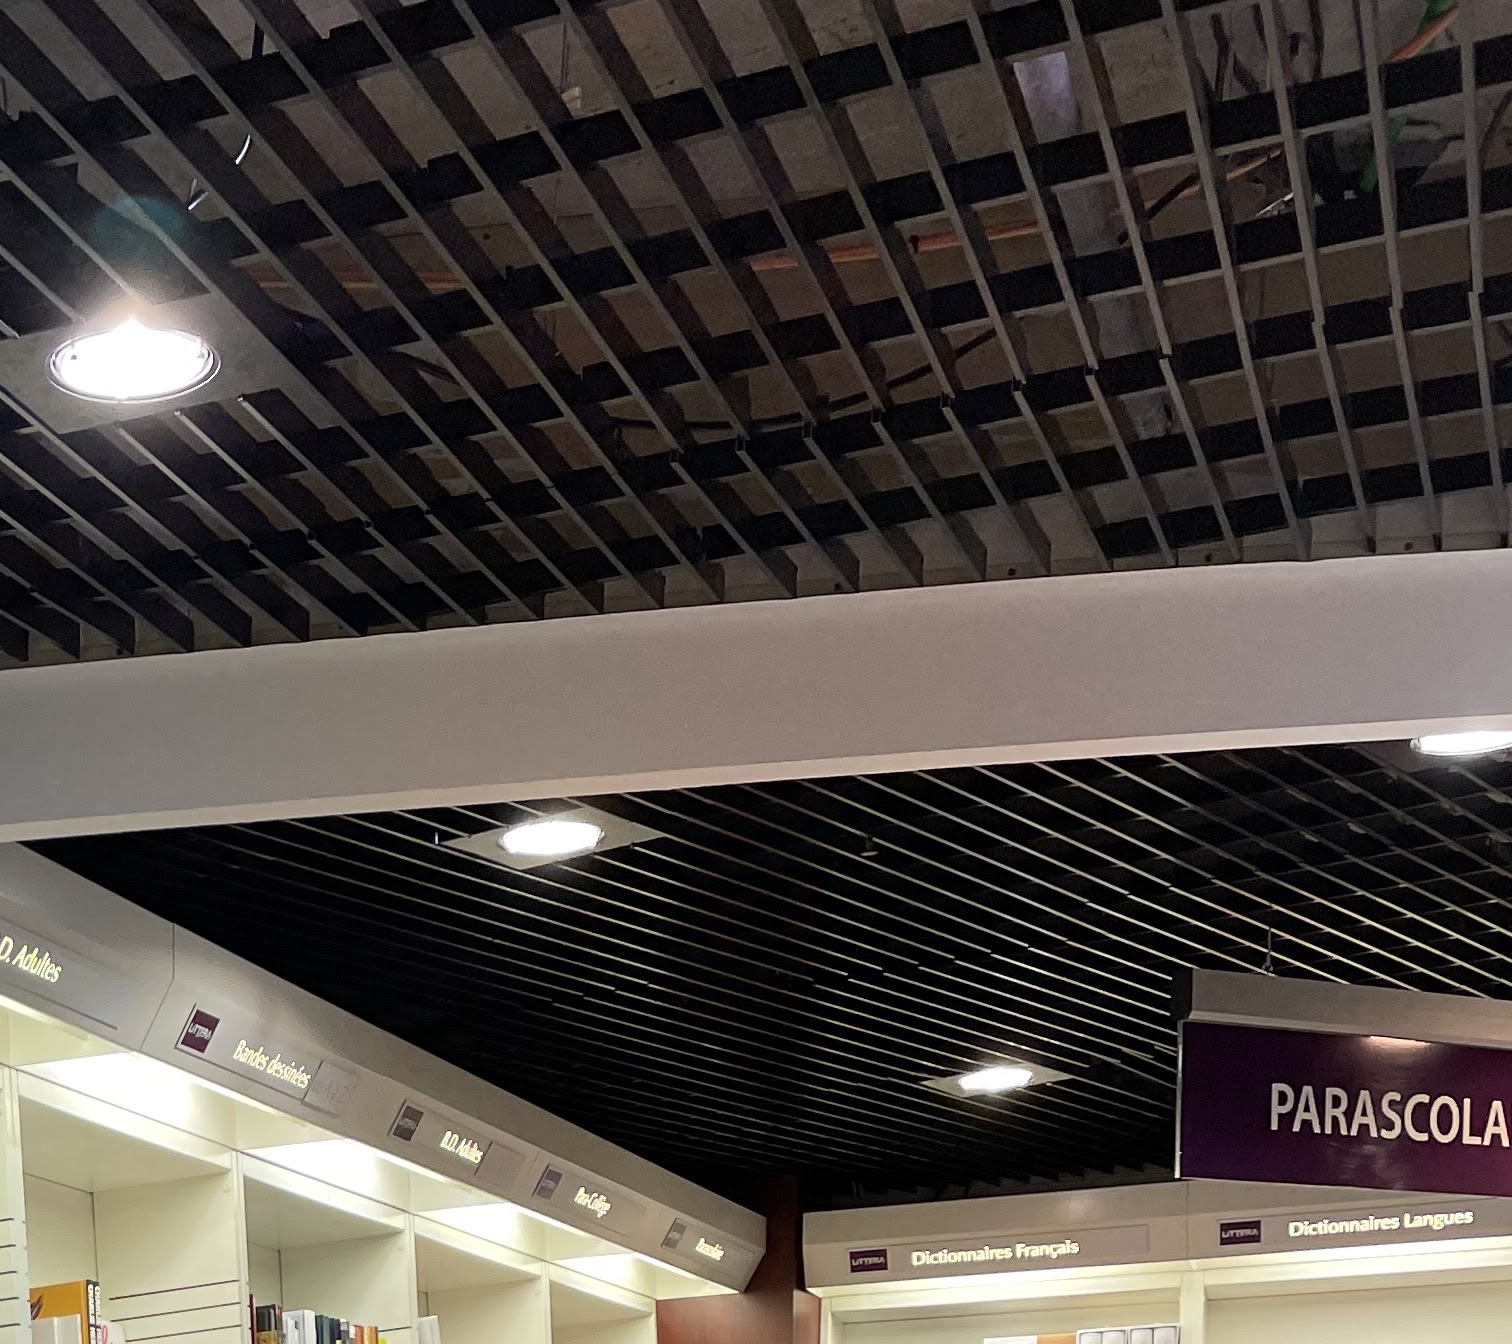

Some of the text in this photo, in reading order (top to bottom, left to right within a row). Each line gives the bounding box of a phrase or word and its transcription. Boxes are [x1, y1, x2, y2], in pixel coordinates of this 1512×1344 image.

[13, 944, 62, 984] Adultes
[232, 1040, 310, 1090] Bandes dessinées
[1288, 1207, 1474, 1238] Dictionnaires Langues
[911, 1239, 1080, 1267] Dictionnaires Français
